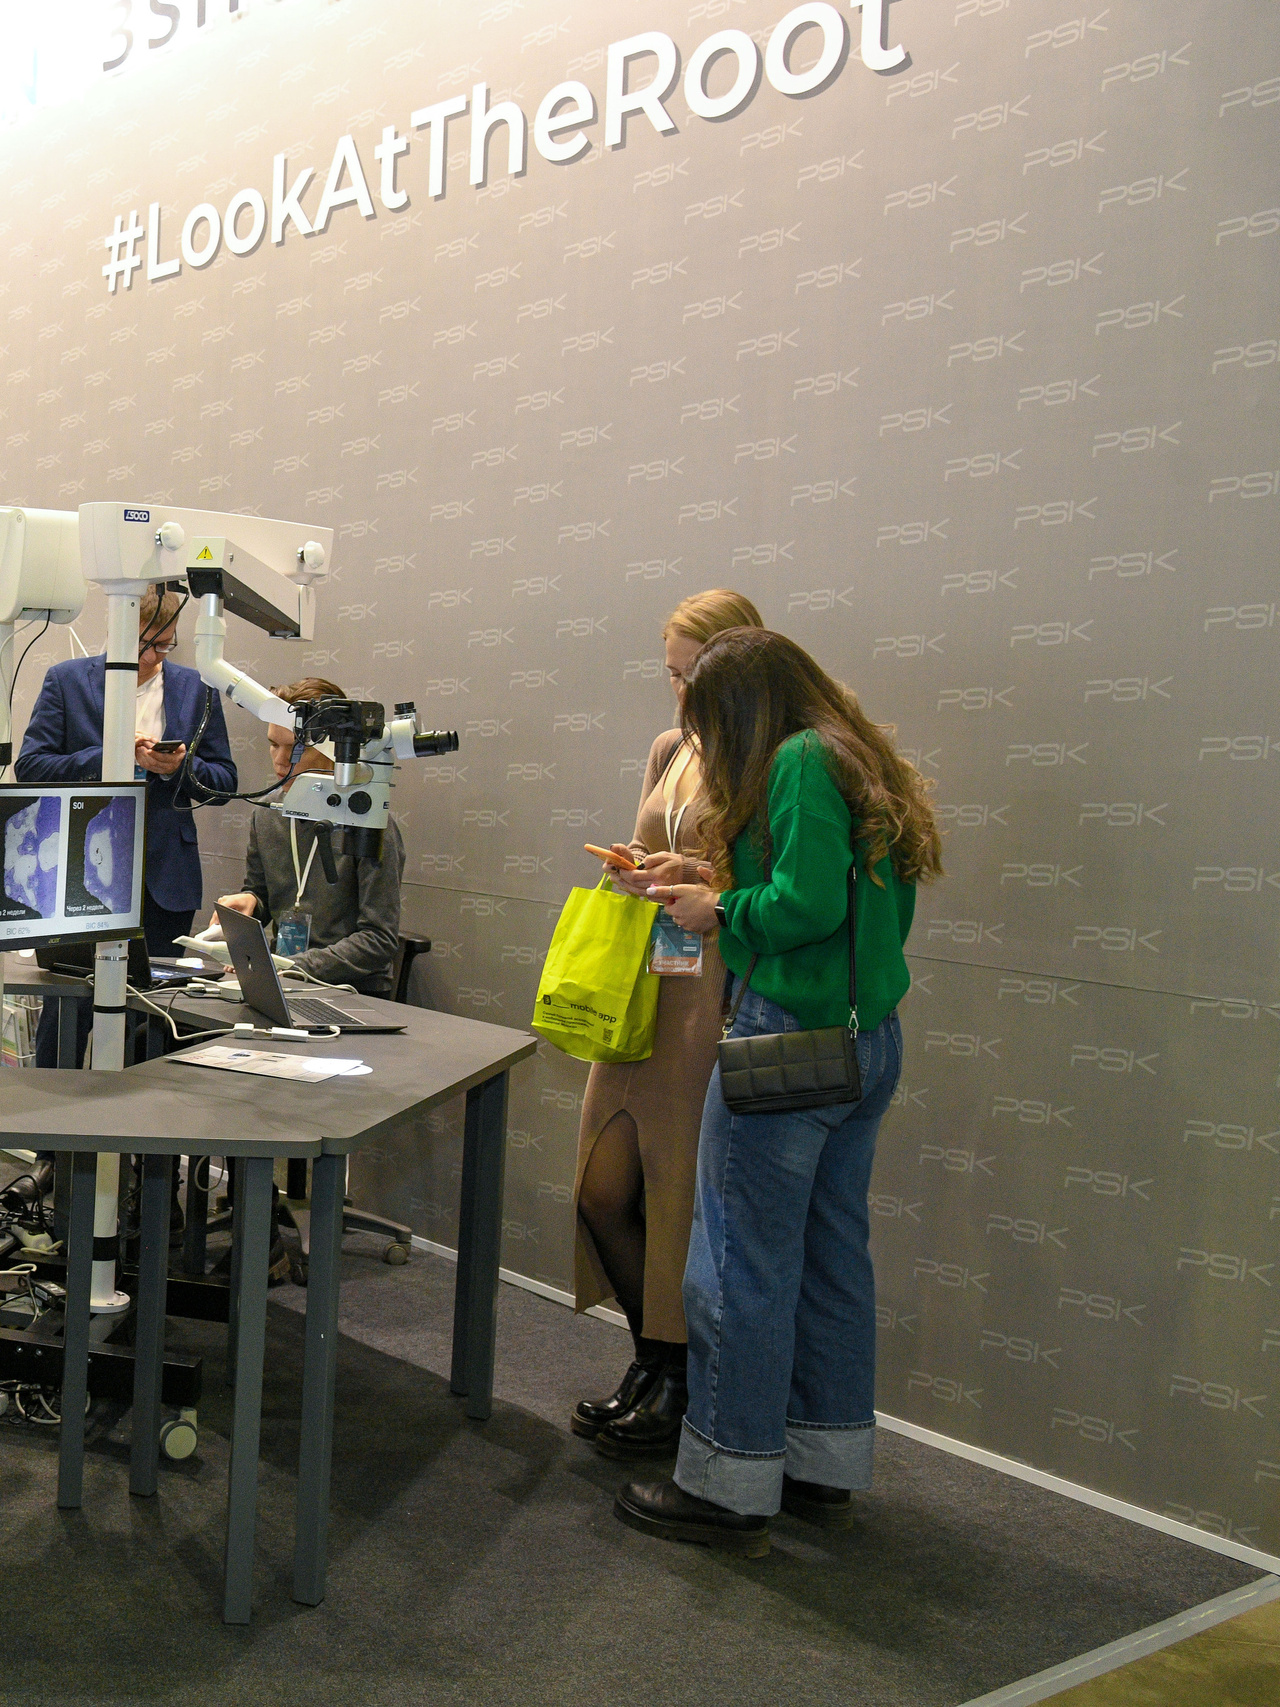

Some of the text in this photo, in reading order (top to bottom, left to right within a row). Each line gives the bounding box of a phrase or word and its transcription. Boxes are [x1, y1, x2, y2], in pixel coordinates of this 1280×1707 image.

[1025, 8, 1110, 58] PSK
[1101, 41, 1192, 92] PSK
[885, 62, 960, 106] PSK
[951, 94, 1031, 140] PSK
[101, 0, 908, 293] #LookAtTheRoot
[739, 116, 804, 157] PSK
[1022, 130, 1107, 175] PSK
[633, 157, 690, 193] PSK
[797, 149, 864, 189] PSK
[883, 175, 958, 216] PSK
[1097, 167, 1190, 214] PSK
[518, 200, 568, 233] PSK
[684, 188, 745, 224] PSK
[563, 231, 616, 264] PSK
[738, 222, 802, 259] PSK
[949, 212, 1029, 253] PSK
[474, 262, 522, 292] PSK
[631, 256, 688, 290] PSK
[795, 257, 862, 294] PSK
[1020, 252, 1104, 293] PSK
[516, 293, 567, 323] PSK
[682, 291, 743, 324] PSK
[881, 289, 955, 326] PSK
[1095, 294, 1186, 336] PSK
[561, 326, 614, 356] PSK
[735, 328, 800, 361] PSK
[947, 330, 1026, 367] PSK
[473, 353, 520, 381] PSK
[629, 356, 686, 387] PSK
[793, 367, 860, 400] PSK
[1017, 374, 1101, 411] PSK
[514, 387, 565, 414] PSK
[680, 394, 741, 424] PSK
[879, 403, 953, 437] PSK
[559, 423, 612, 450] PSK
[734, 434, 798, 464] PSK
[1092, 421, 1182, 458] PSK
[471, 444, 519, 470] PSK
[627, 456, 685, 485] PSK
[944, 448, 1023, 481] PSK
[513, 480, 563, 506] PSK
[790, 476, 857, 506] PSK
[678, 497, 738, 525] PSK
[1013, 496, 1098, 530] PSK
[557, 519, 611, 544] PSK
[876, 518, 950, 548] PSK
[469, 535, 517, 559] PSK
[731, 540, 795, 567] PSK
[374, 553, 417, 574] PSK
[625, 557, 682, 582] PSK
[1088, 549, 1178, 581] PSK
[511, 574, 562, 597] PSK
[940, 567, 1019, 596] PSK
[428, 588, 473, 609] PSK
[787, 586, 854, 613] PSK
[467, 627, 515, 648] PSK
[556, 615, 609, 638] PSK
[1009, 619, 1094, 648] PSK
[372, 639, 415, 659] PSK
[872, 633, 946, 659] PSK
[425, 677, 470, 696] PSK
[509, 669, 559, 688] PSK
[1084, 676, 1173, 703] PSK
[937, 686, 1015, 711] PSK
[465, 719, 512, 737] PSK
[553, 711, 606, 732] PSK
[1005, 742, 1089, 766] PSK
[506, 762, 557, 781] PSK
[72, 801, 85, 810] SOI
[463, 810, 510, 827] PSK
[550, 808, 603, 827] PSK
[1078, 803, 1169, 826] PSK
[503, 855, 553, 873] PSK
[1000, 863, 1083, 887] PSK
[1192, 866, 1280, 892] PSK
[459, 898, 506, 916] PSK
[928, 919, 1005, 945] PSK
[1071, 926, 1162, 953] PSK
[458, 987, 505, 1006] PSK
[998, 978, 1083, 1006] PSK
[570, 1003, 598, 1017] mobile
[598, 1012, 617, 1024] app
[924, 1031, 1004, 1060] PSK
[1070, 1045, 1160, 1076] PSK
[991, 1095, 1075, 1127] PSK
[1184, 1119, 1280, 1154] PSK
[918, 1144, 997, 1178] PSK
[1064, 1166, 1154, 1201] PSK
[986, 1214, 1070, 1250] PSK
[913, 1257, 990, 1292] PSK
[1175, 1247, 1275, 1287] PSK
[1057, 1287, 1146, 1327] PSK
[981, 1330, 1061, 1369] PSK
[907, 1370, 984, 1409] PSK
[1169, 1374, 1268, 1418] PSK
[1051, 1407, 1139, 1451] PSK
